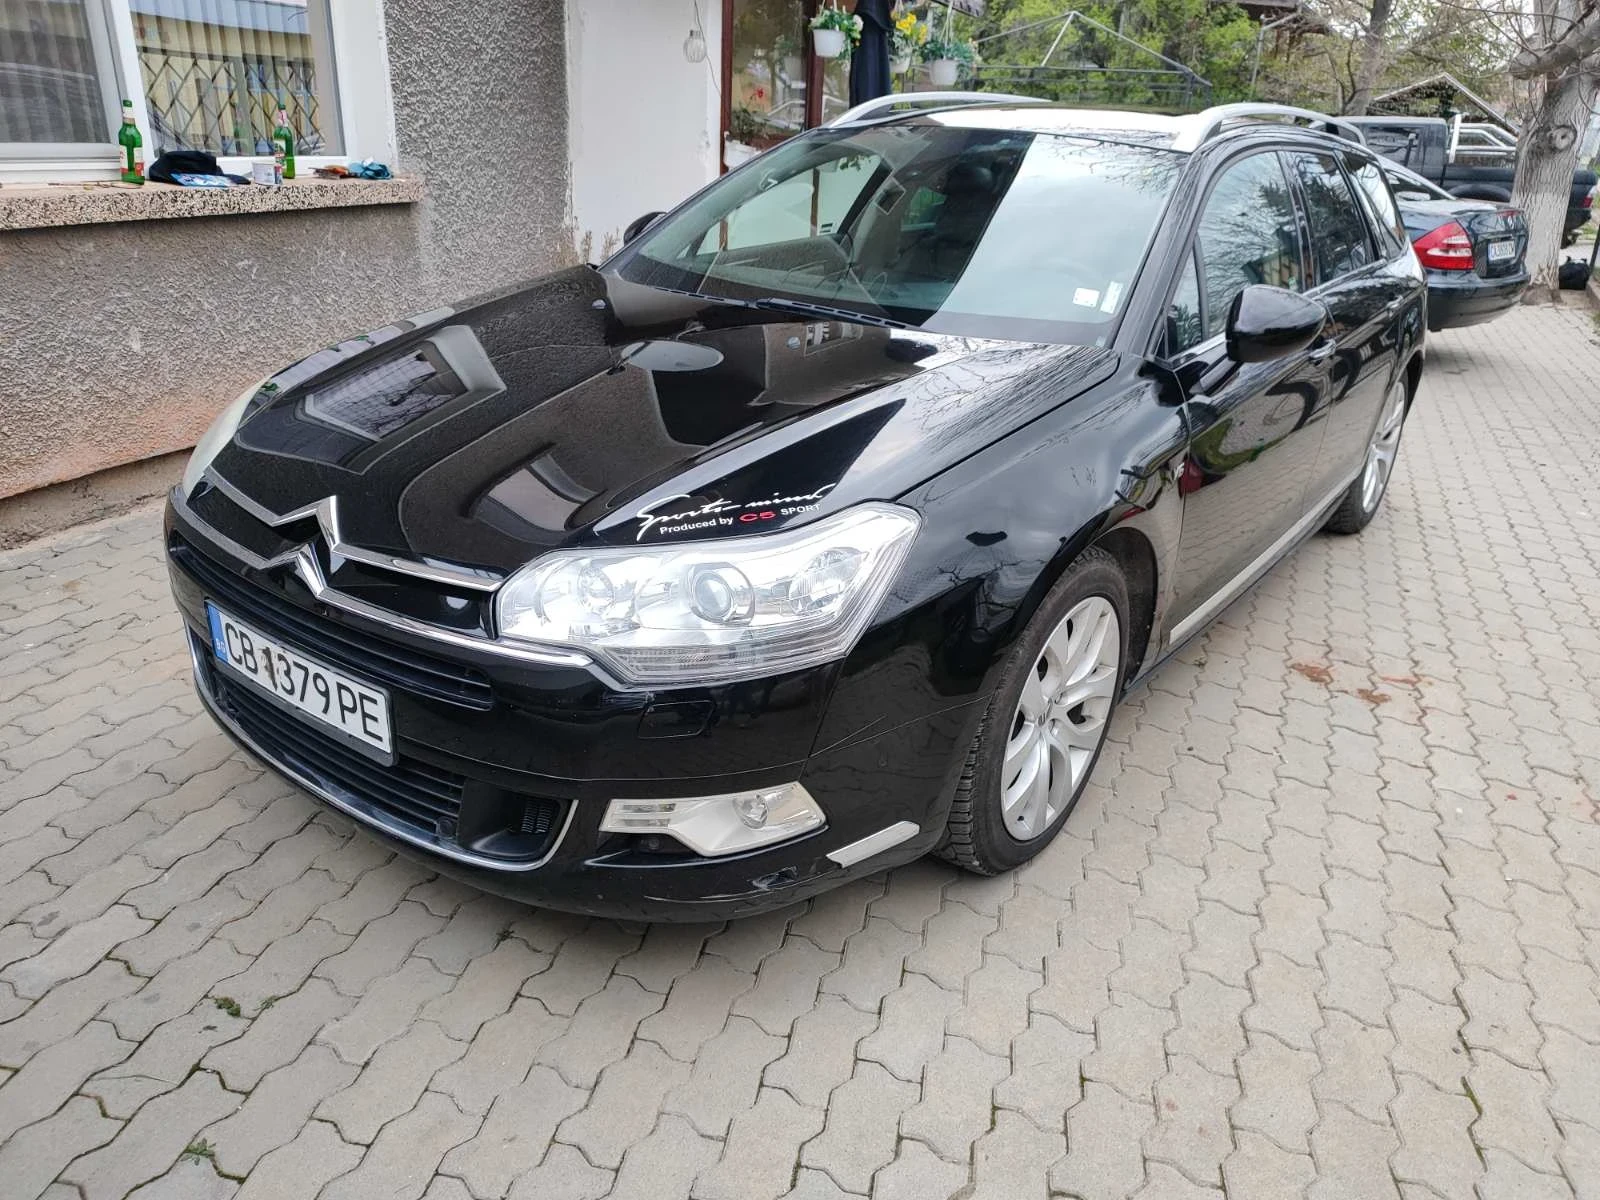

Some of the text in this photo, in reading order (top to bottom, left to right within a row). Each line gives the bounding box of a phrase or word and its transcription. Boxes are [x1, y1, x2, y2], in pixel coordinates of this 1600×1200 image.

[659, 503, 821, 535] Produced by C5 SPORT
